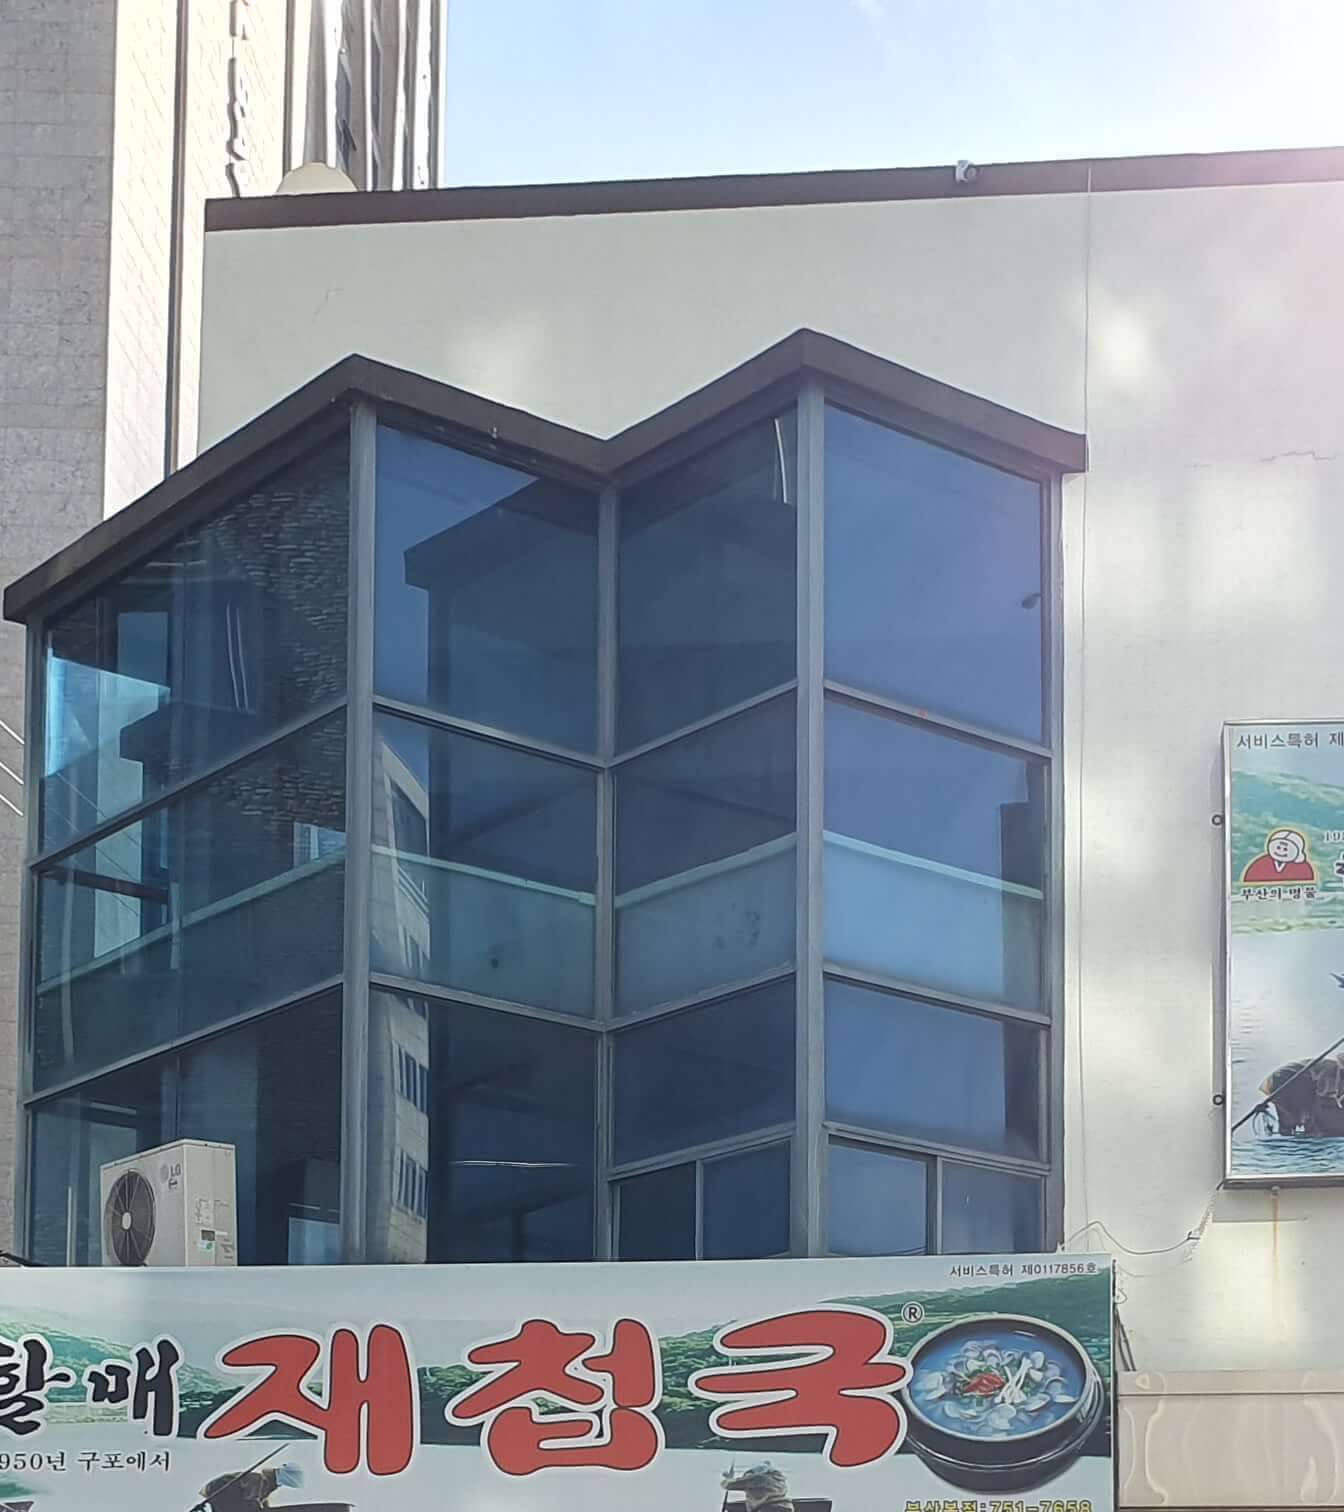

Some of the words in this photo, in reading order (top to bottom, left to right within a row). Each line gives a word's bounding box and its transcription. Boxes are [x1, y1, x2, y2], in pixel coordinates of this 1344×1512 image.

[1236, 732, 1319, 750] 서비스특허
[949, 1263, 1014, 1279] 서비스특허
[1021, 1262, 1097, 1276] 제0117856호
[203, 1309, 907, 1477] 재첩국
[76, 1450, 171, 1473] 구포에서
